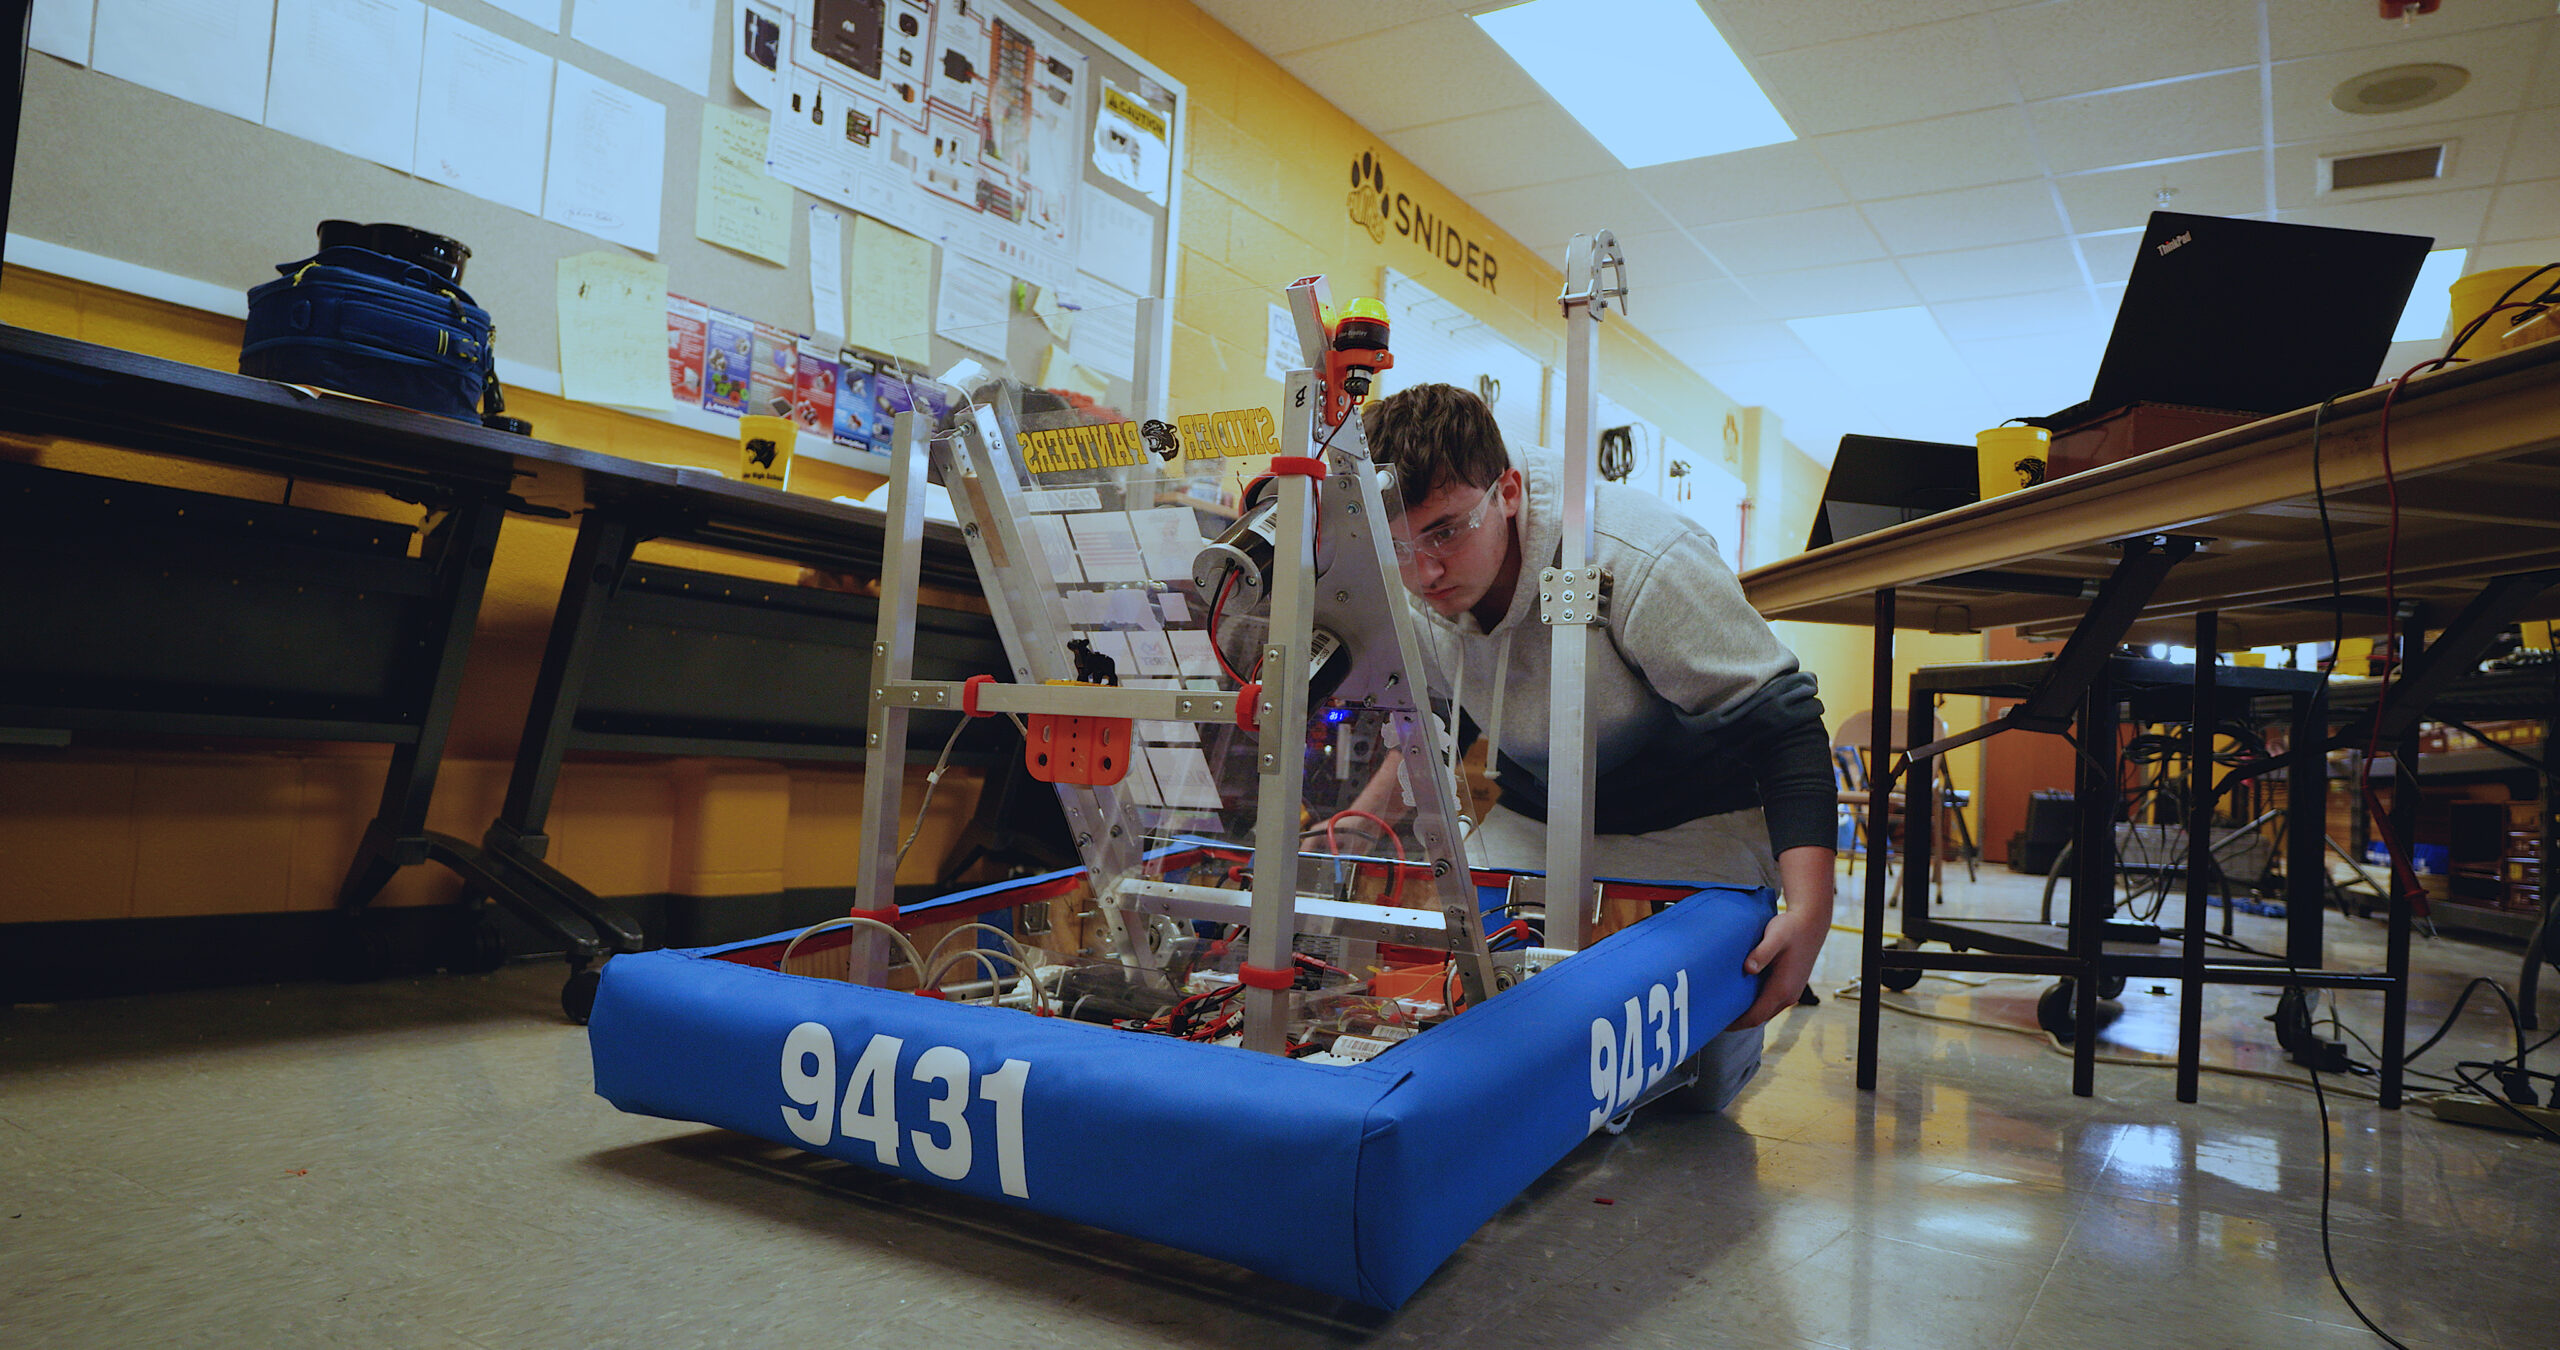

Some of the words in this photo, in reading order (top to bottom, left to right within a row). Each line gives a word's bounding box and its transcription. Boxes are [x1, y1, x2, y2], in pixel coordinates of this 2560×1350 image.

[1120, 100, 1164, 134] CAUTION
[1395, 192, 1497, 295] SNIDER
[2156, 230, 2192, 257] ThinkPad
[1588, 968, 1689, 1138] 9431
[780, 1021, 1032, 1200] 9431
